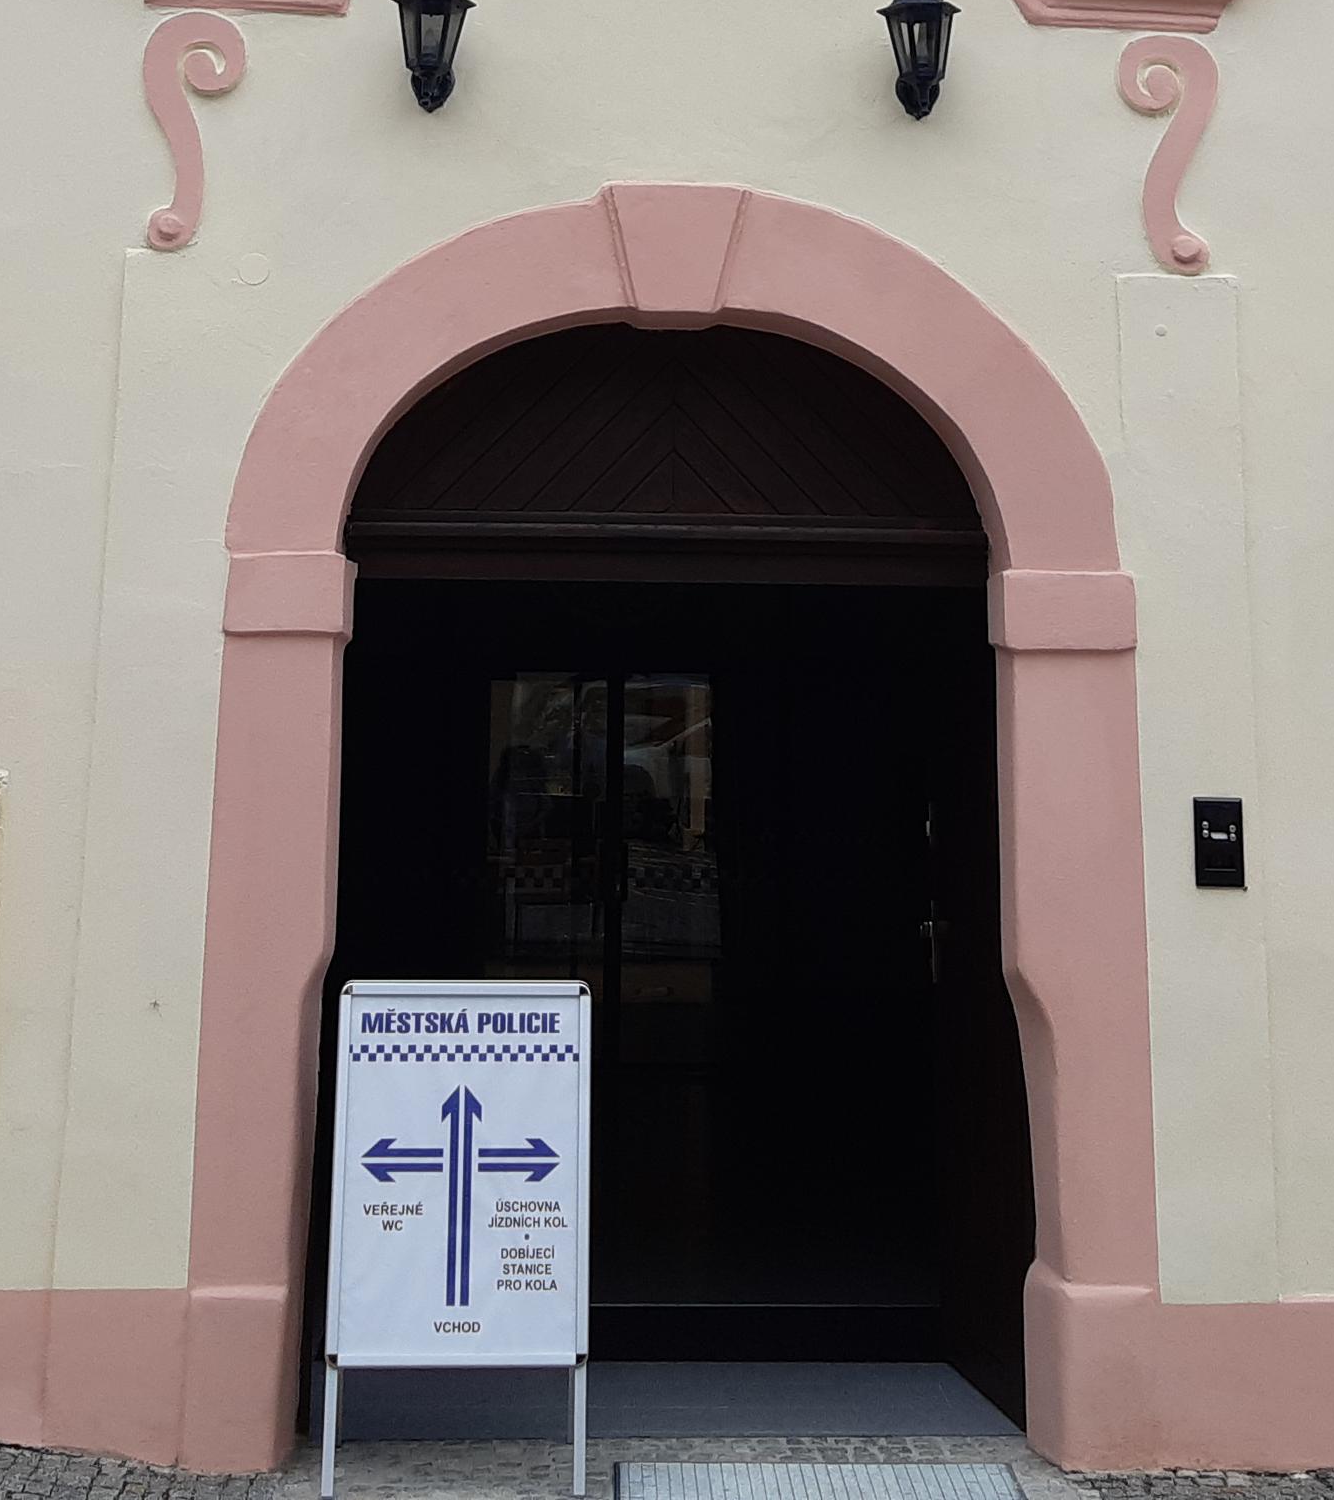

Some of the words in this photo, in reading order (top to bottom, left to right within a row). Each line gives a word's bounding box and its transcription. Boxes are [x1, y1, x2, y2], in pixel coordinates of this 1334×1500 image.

[360, 1008, 470, 1035] MĚSTSKÁ
[477, 1011, 561, 1035] POLICIE
[362, 1200, 424, 1216] VEŘEJNÉ
[495, 1198, 561, 1213] ÚSCHOVNA
[381, 1219, 403, 1232] WC
[487, 1213, 541, 1228] JÍZDNÍCH
[544, 1216, 568, 1228] KOL
[500, 1245, 555, 1259] DOBÍJECÍ
[502, 1263, 552, 1275] STANICE
[496, 1279, 522, 1291] PRO
[525, 1279, 558, 1291] KOLA
[433, 1321, 481, 1334] VCHOD
